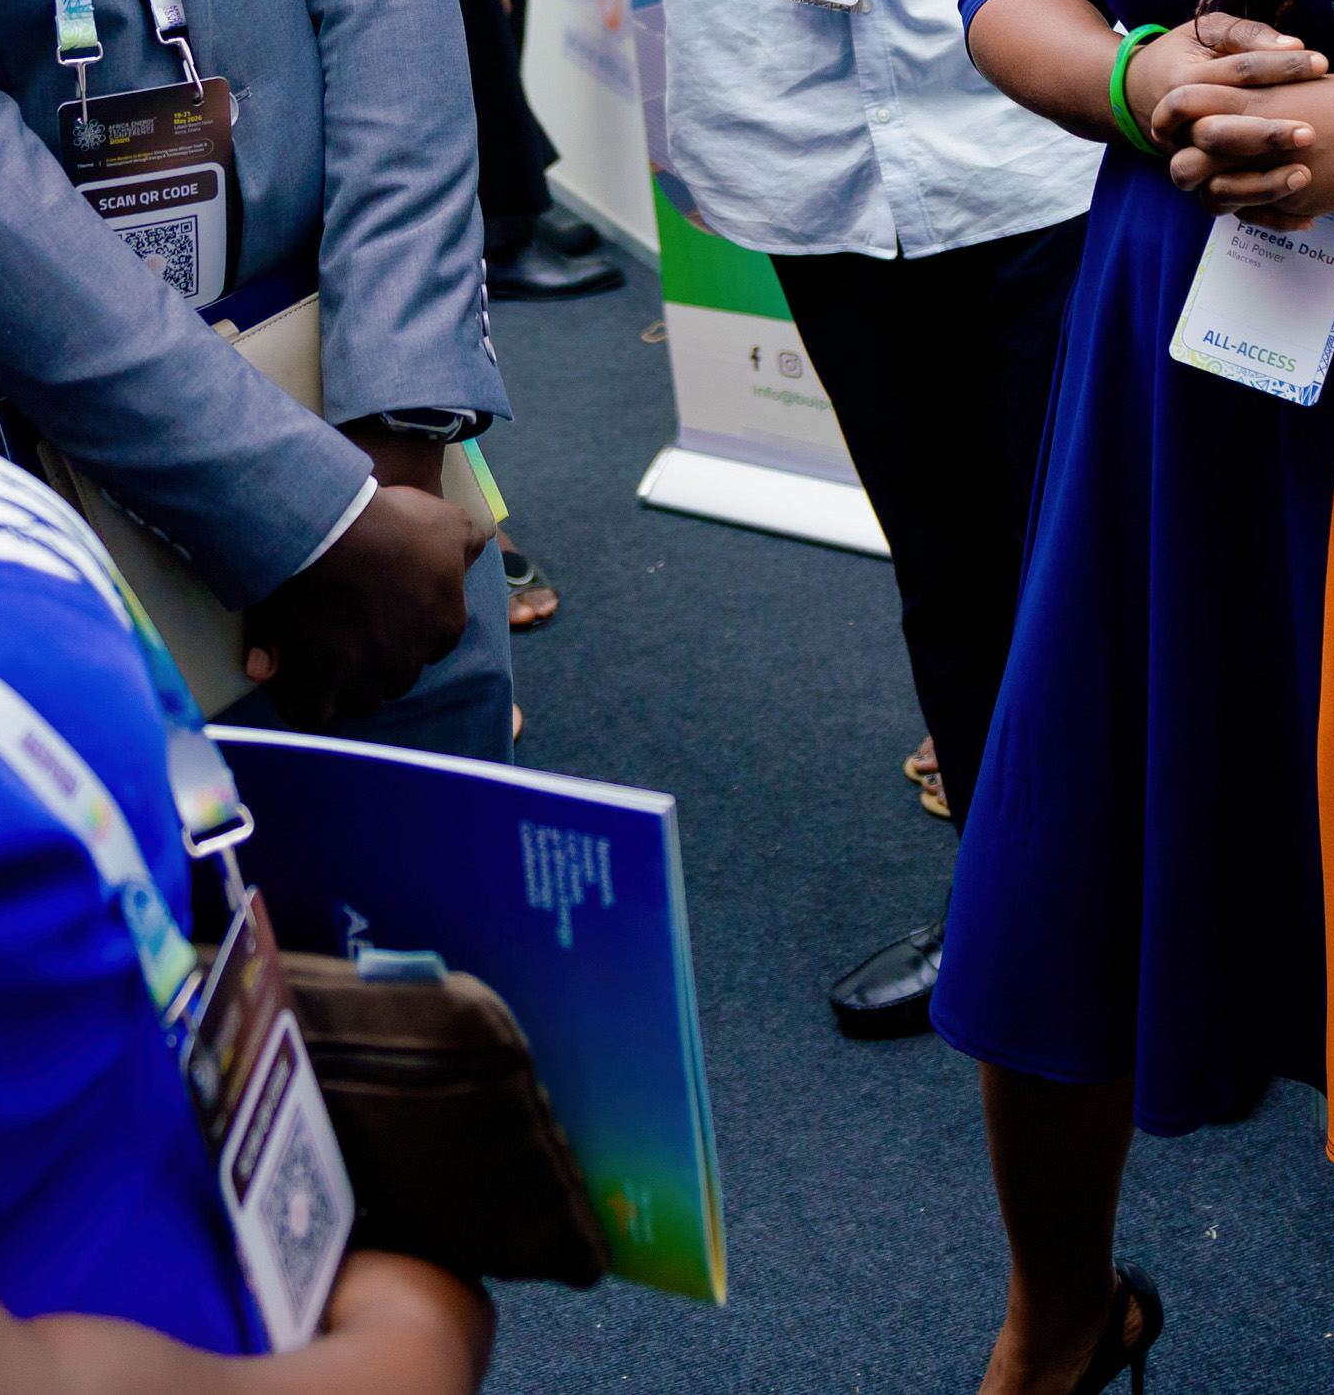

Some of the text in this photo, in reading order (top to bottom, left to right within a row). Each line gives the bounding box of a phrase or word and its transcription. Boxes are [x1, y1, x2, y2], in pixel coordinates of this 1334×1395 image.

[99, 183, 199, 211] SCAN QR CODE
[1231, 236, 1285, 264] Bui Power
[1236, 221, 1334, 266] Fareeda Doku
[1226, 249, 1263, 269] Allaccess
[1203, 329, 1298, 373] ALL-ACCESS
